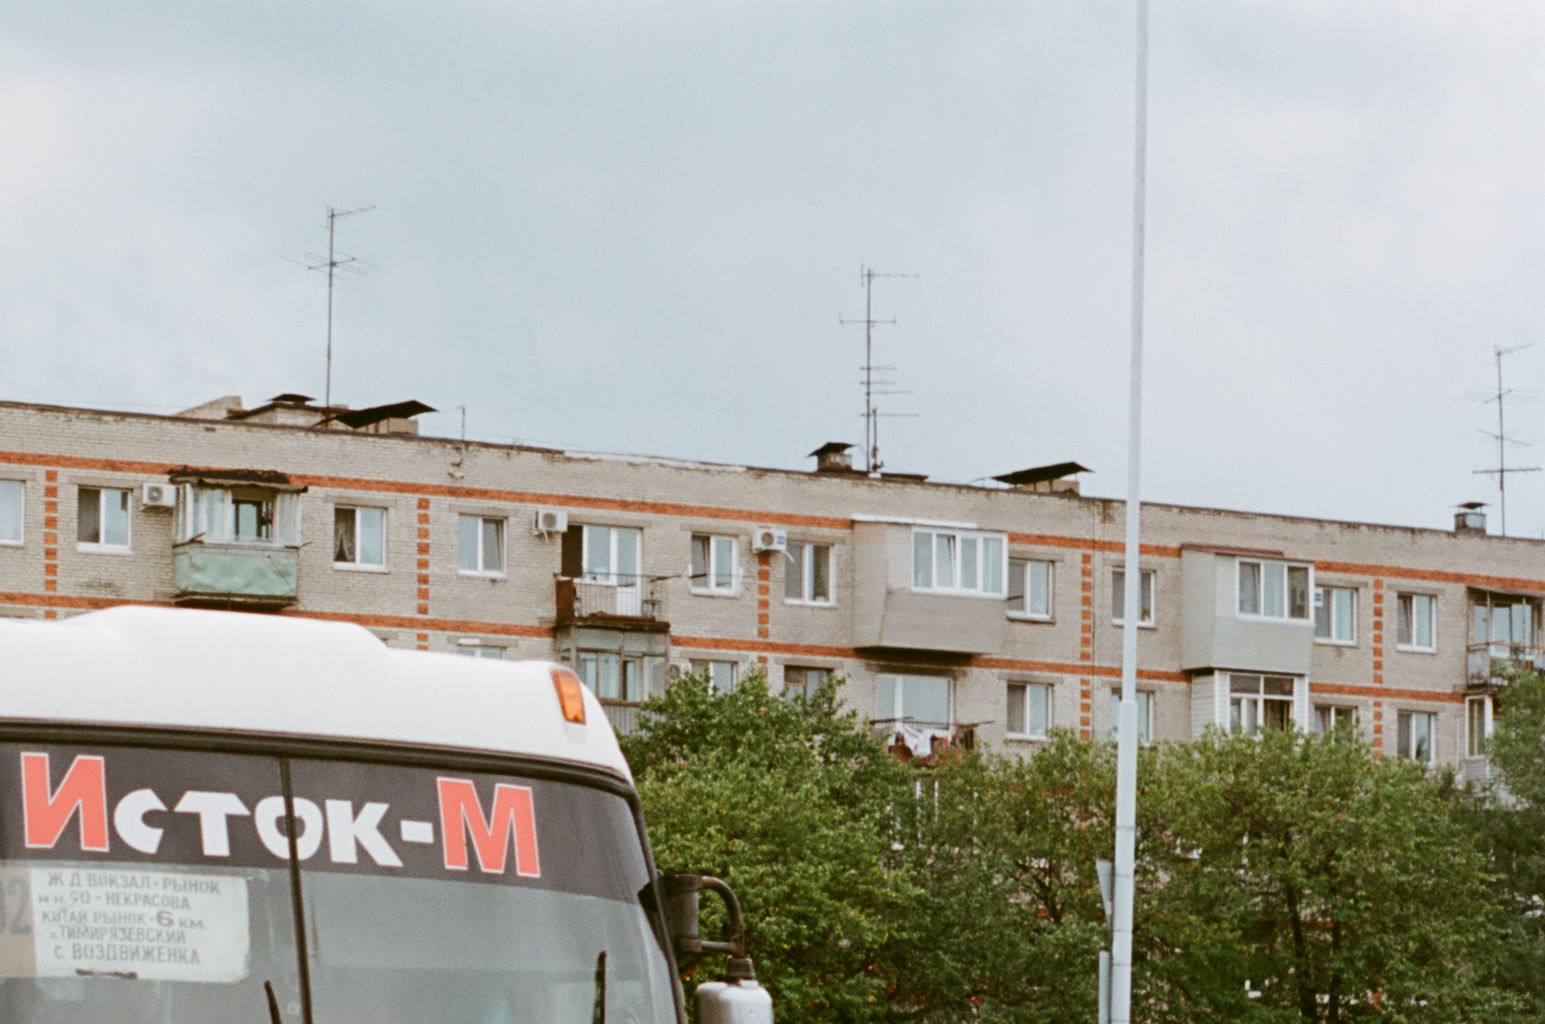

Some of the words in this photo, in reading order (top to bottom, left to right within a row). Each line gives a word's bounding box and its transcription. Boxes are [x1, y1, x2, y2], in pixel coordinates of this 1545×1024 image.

[87, 872, 150, 890] ВОКЗАЛ
[162, 876, 221, 895] РЫНОК
[105, 891, 191, 911] НЕКРАСОВА
[94, 911, 147, 926] РЫНОК
[156, 910, 175, 927] 6
[72, 943, 202, 966] ВОЗДВИЖЕНКА
